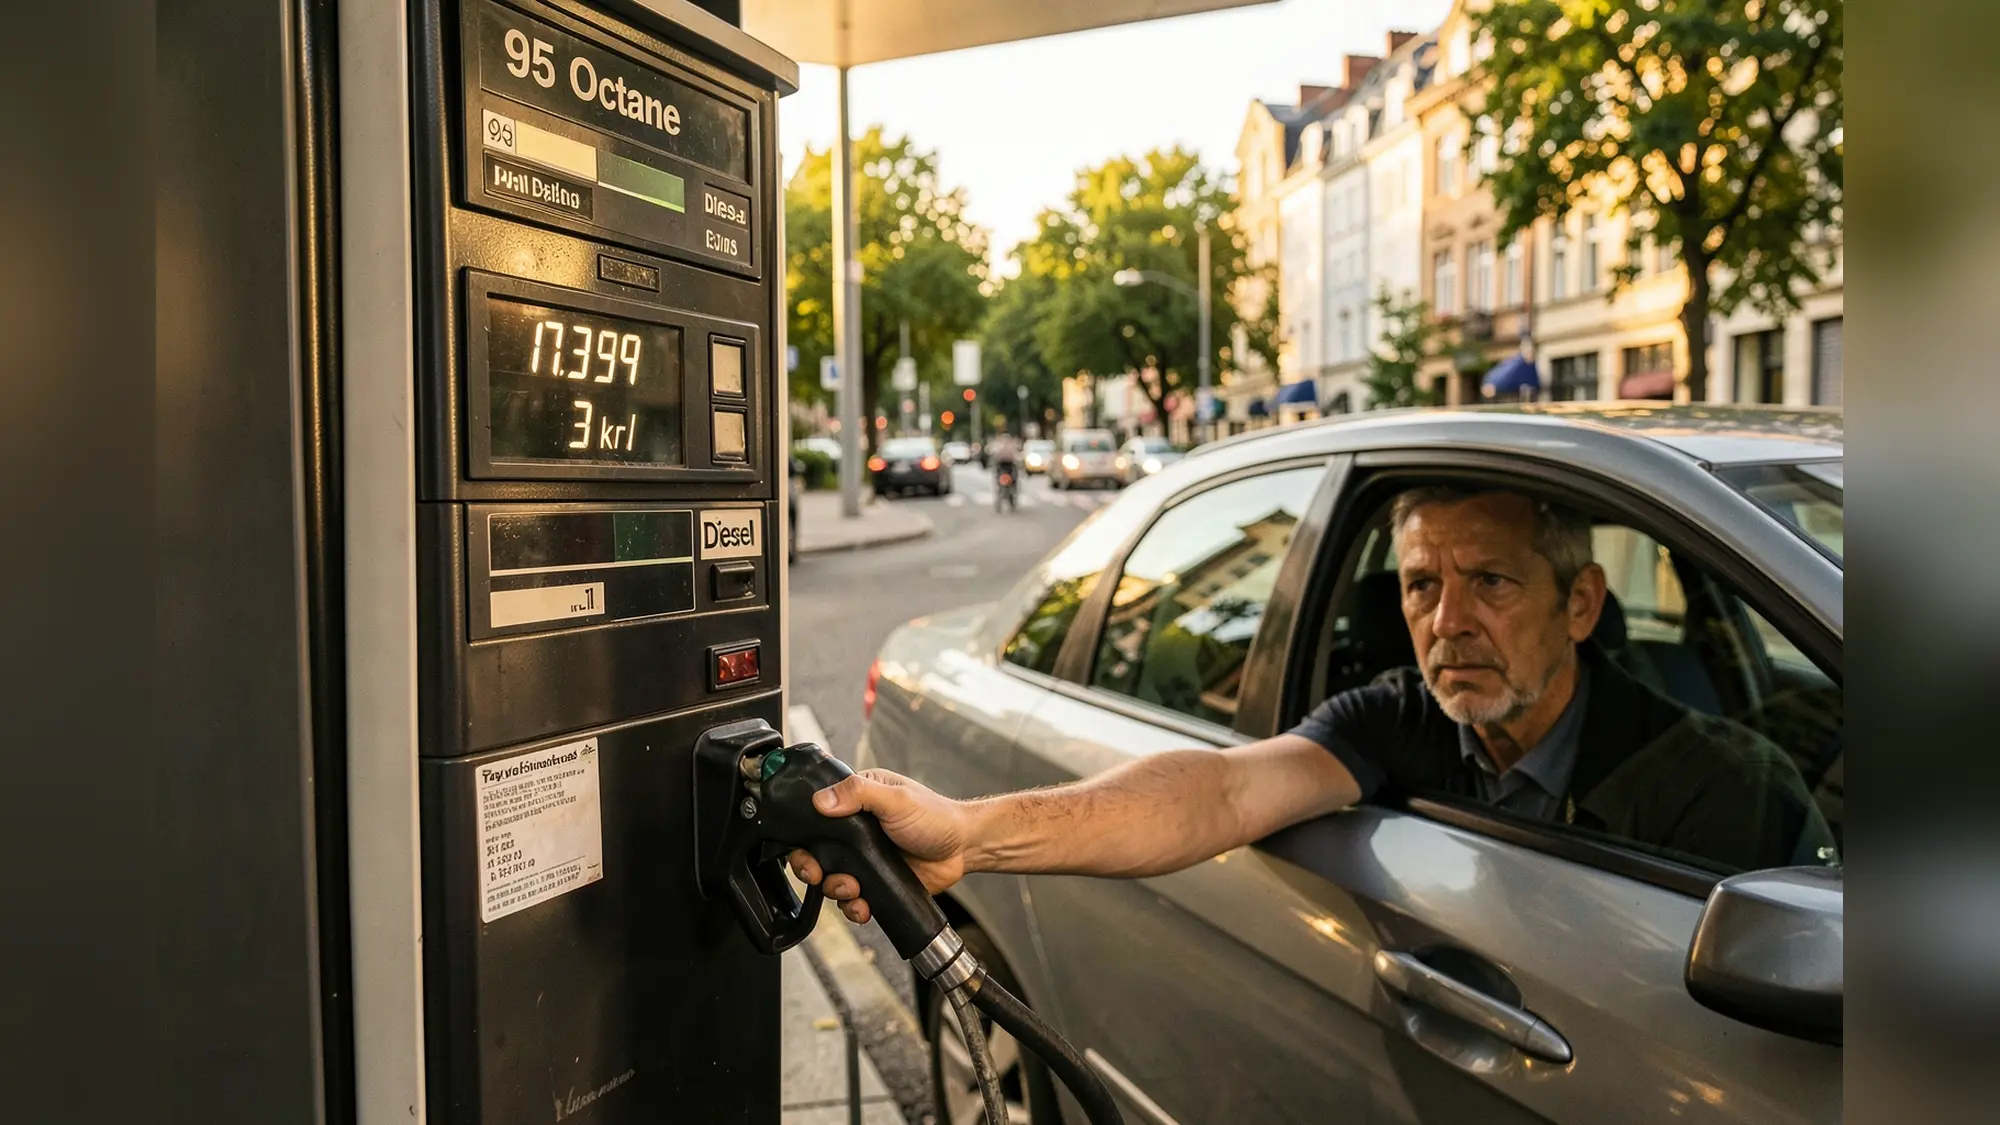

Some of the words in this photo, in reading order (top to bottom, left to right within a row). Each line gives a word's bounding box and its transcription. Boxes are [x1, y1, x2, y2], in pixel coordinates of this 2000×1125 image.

[504, 28, 556, 88] 95
[569, 56, 681, 136] Octane
[568, 400, 593, 450] 3
